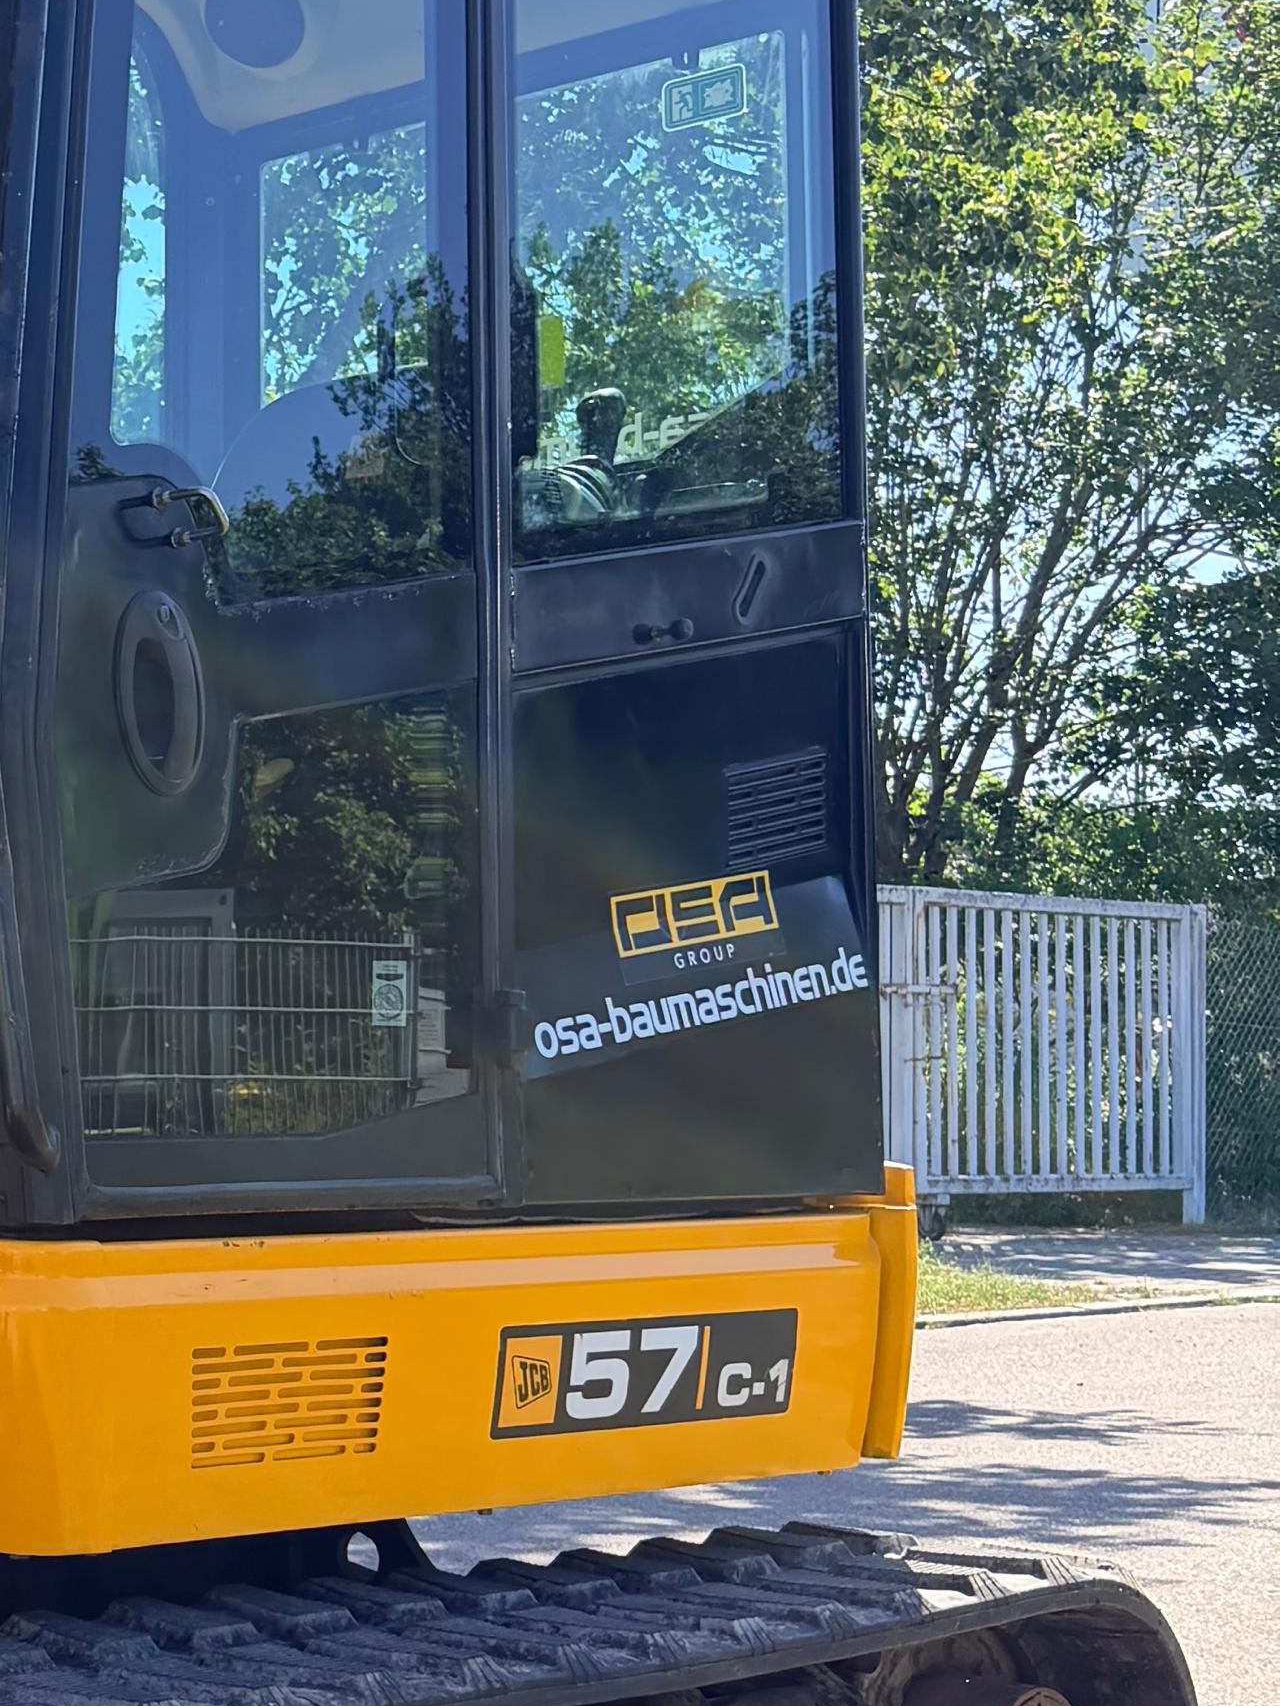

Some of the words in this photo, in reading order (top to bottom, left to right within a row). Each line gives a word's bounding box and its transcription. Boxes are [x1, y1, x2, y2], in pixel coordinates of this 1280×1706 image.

[673, 943, 736, 970] GROUP
[534, 946, 869, 1059] osa-baumaschinen.de
[516, 1360, 550, 1403] JCB
[565, 1325, 700, 1420] 57
